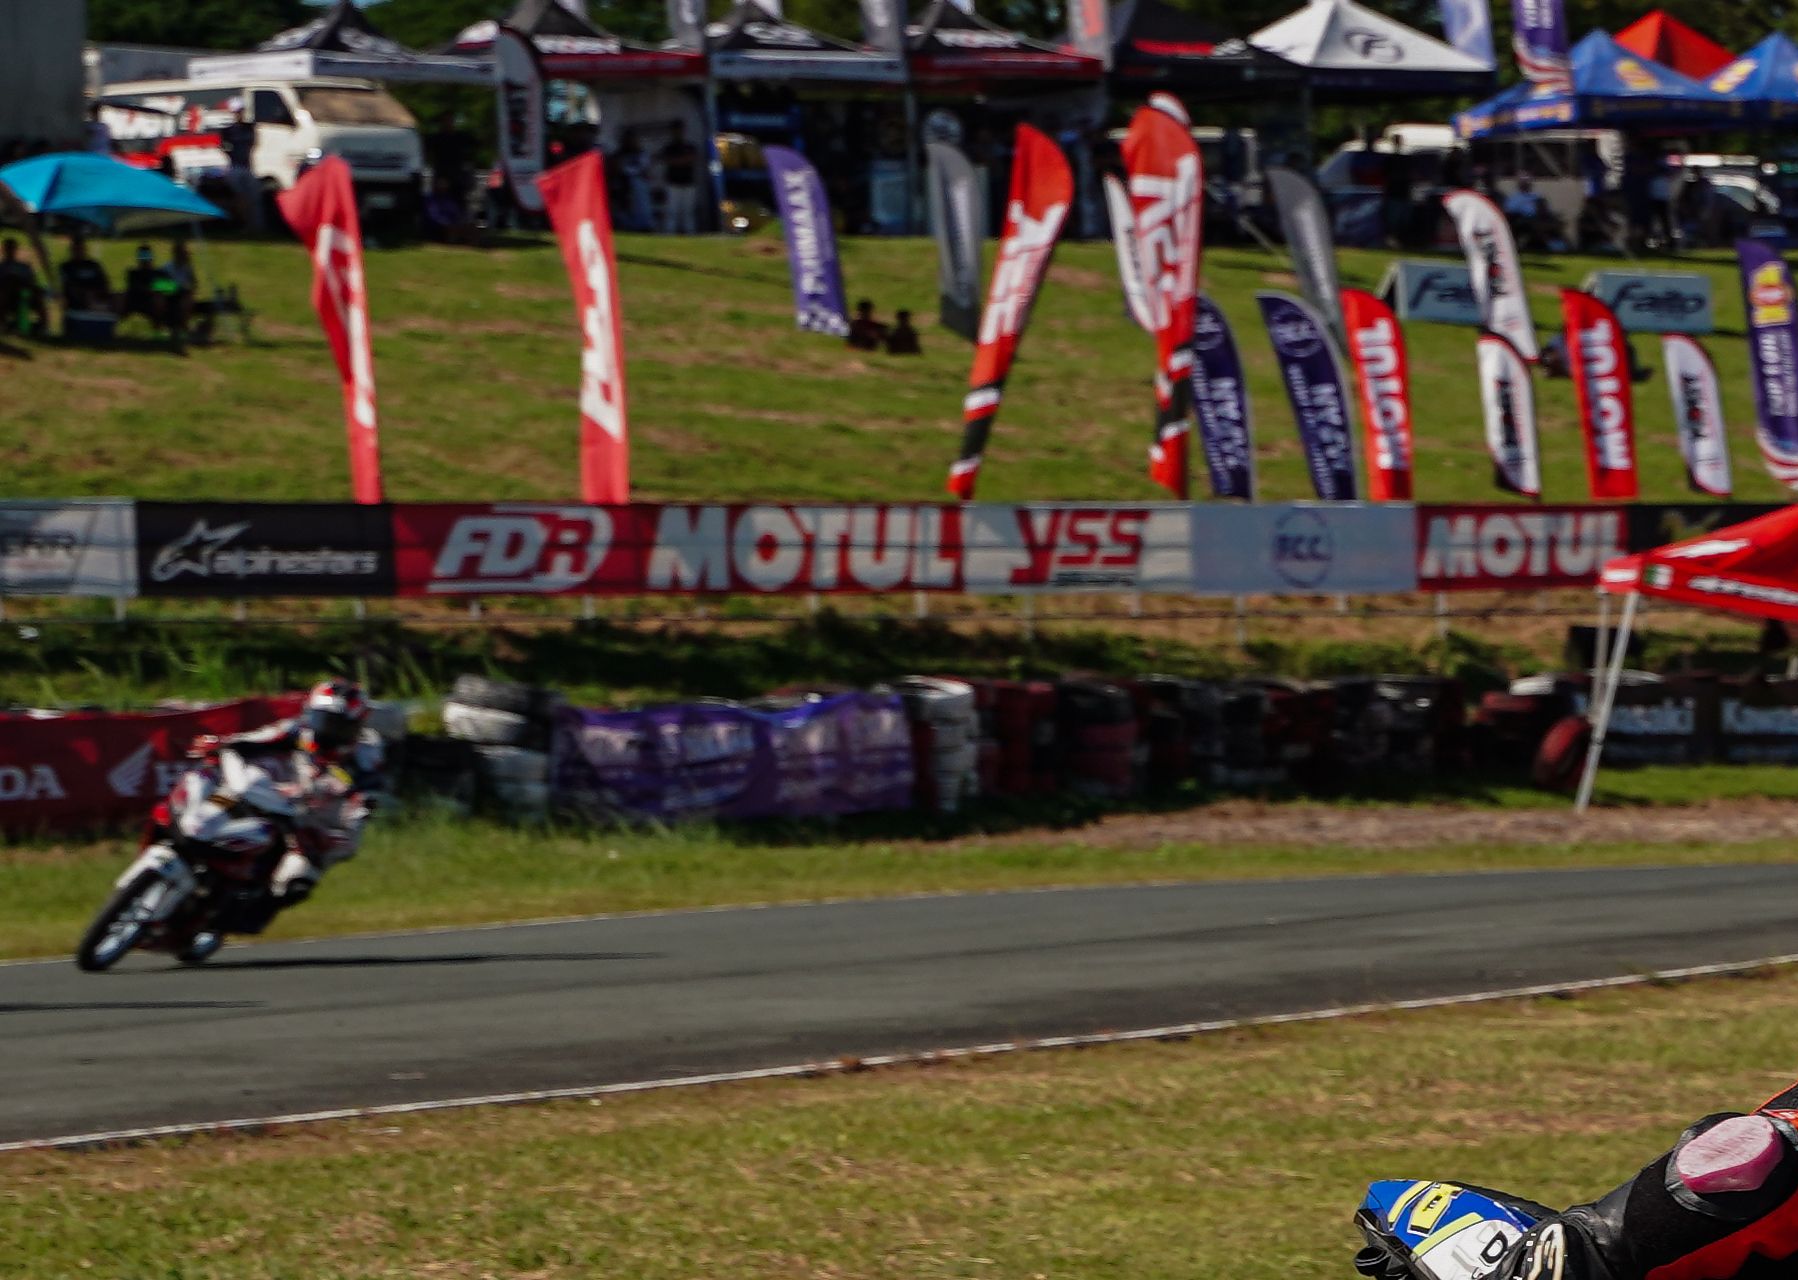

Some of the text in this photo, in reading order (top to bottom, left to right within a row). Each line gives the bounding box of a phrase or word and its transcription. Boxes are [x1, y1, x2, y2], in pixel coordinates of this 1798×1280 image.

[1356, 317, 1410, 471] MOTUL
[1578, 319, 1632, 471] MOTUL
[212, 547, 379, 577] alpinestars
[434, 515, 598, 579] FDR
[648, 506, 963, 592] MOTUL
[1009, 508, 1150, 585] YSS
[1420, 511, 1626, 577] MOTUL
